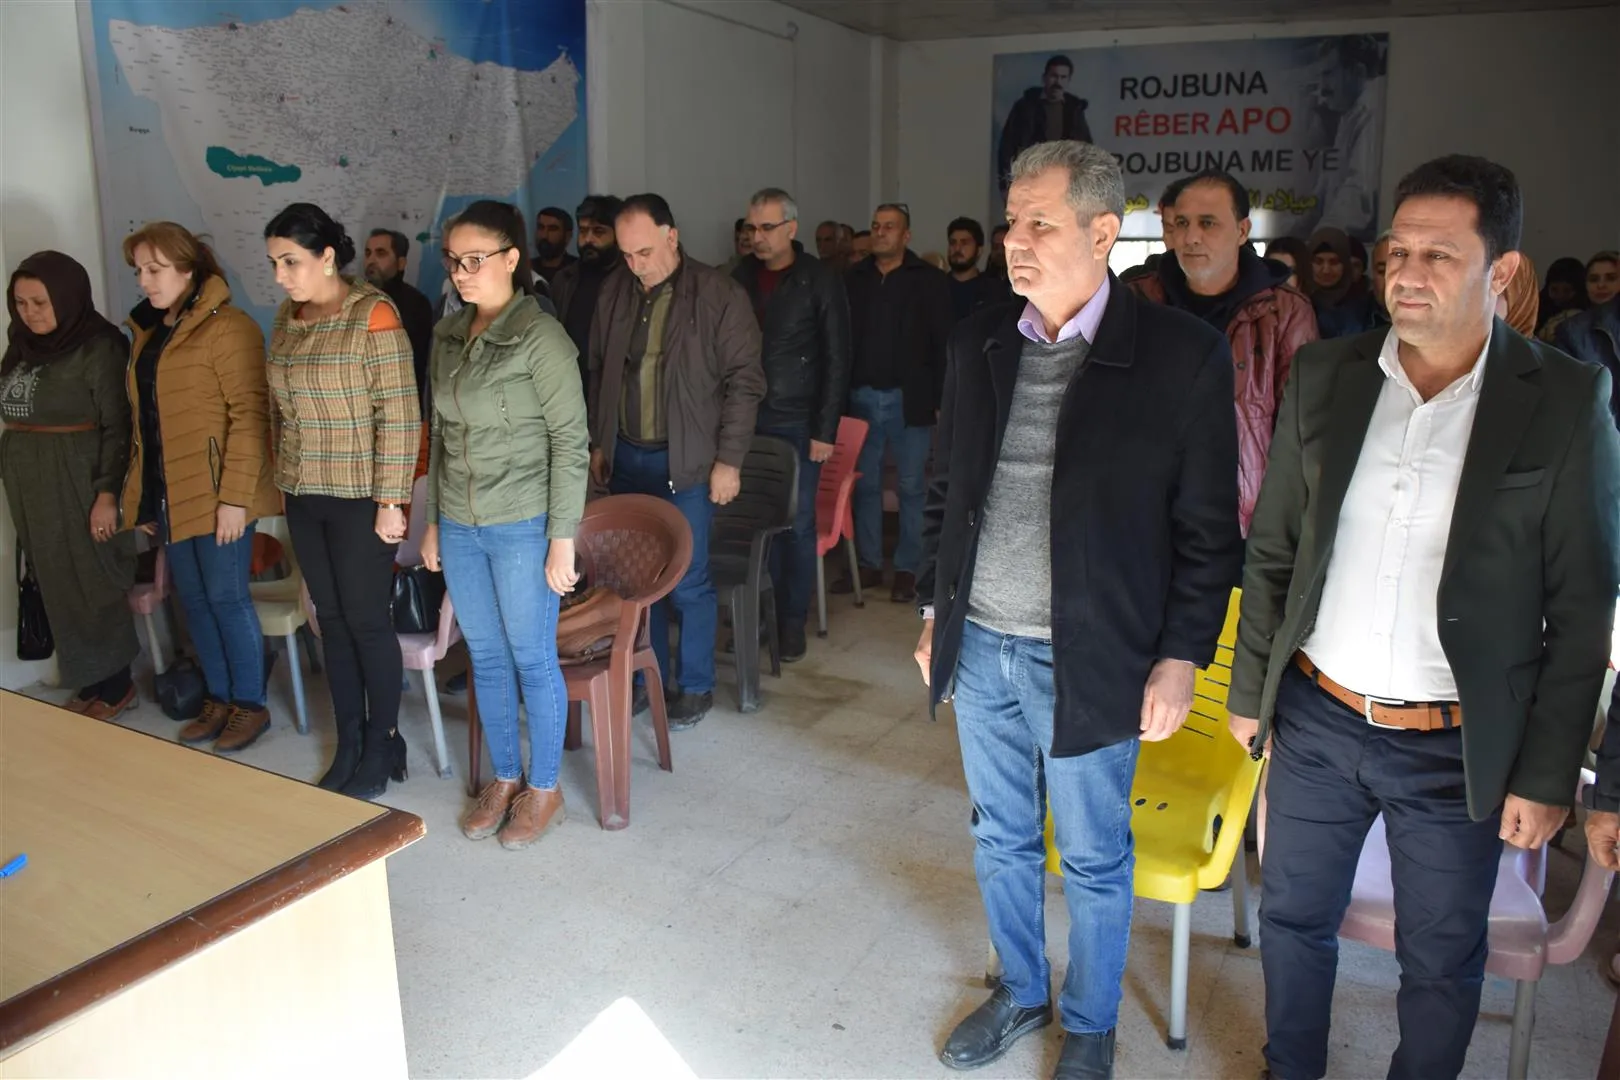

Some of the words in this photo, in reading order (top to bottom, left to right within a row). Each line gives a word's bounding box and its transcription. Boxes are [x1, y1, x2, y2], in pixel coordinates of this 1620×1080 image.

[1120, 71, 1268, 100] ROJBUNA
[1115, 110, 1210, 137] RÊBER
[1216, 106, 1292, 135] APO
[1251, 149, 1293, 173] ME
[1302, 148, 1339, 172] YE
